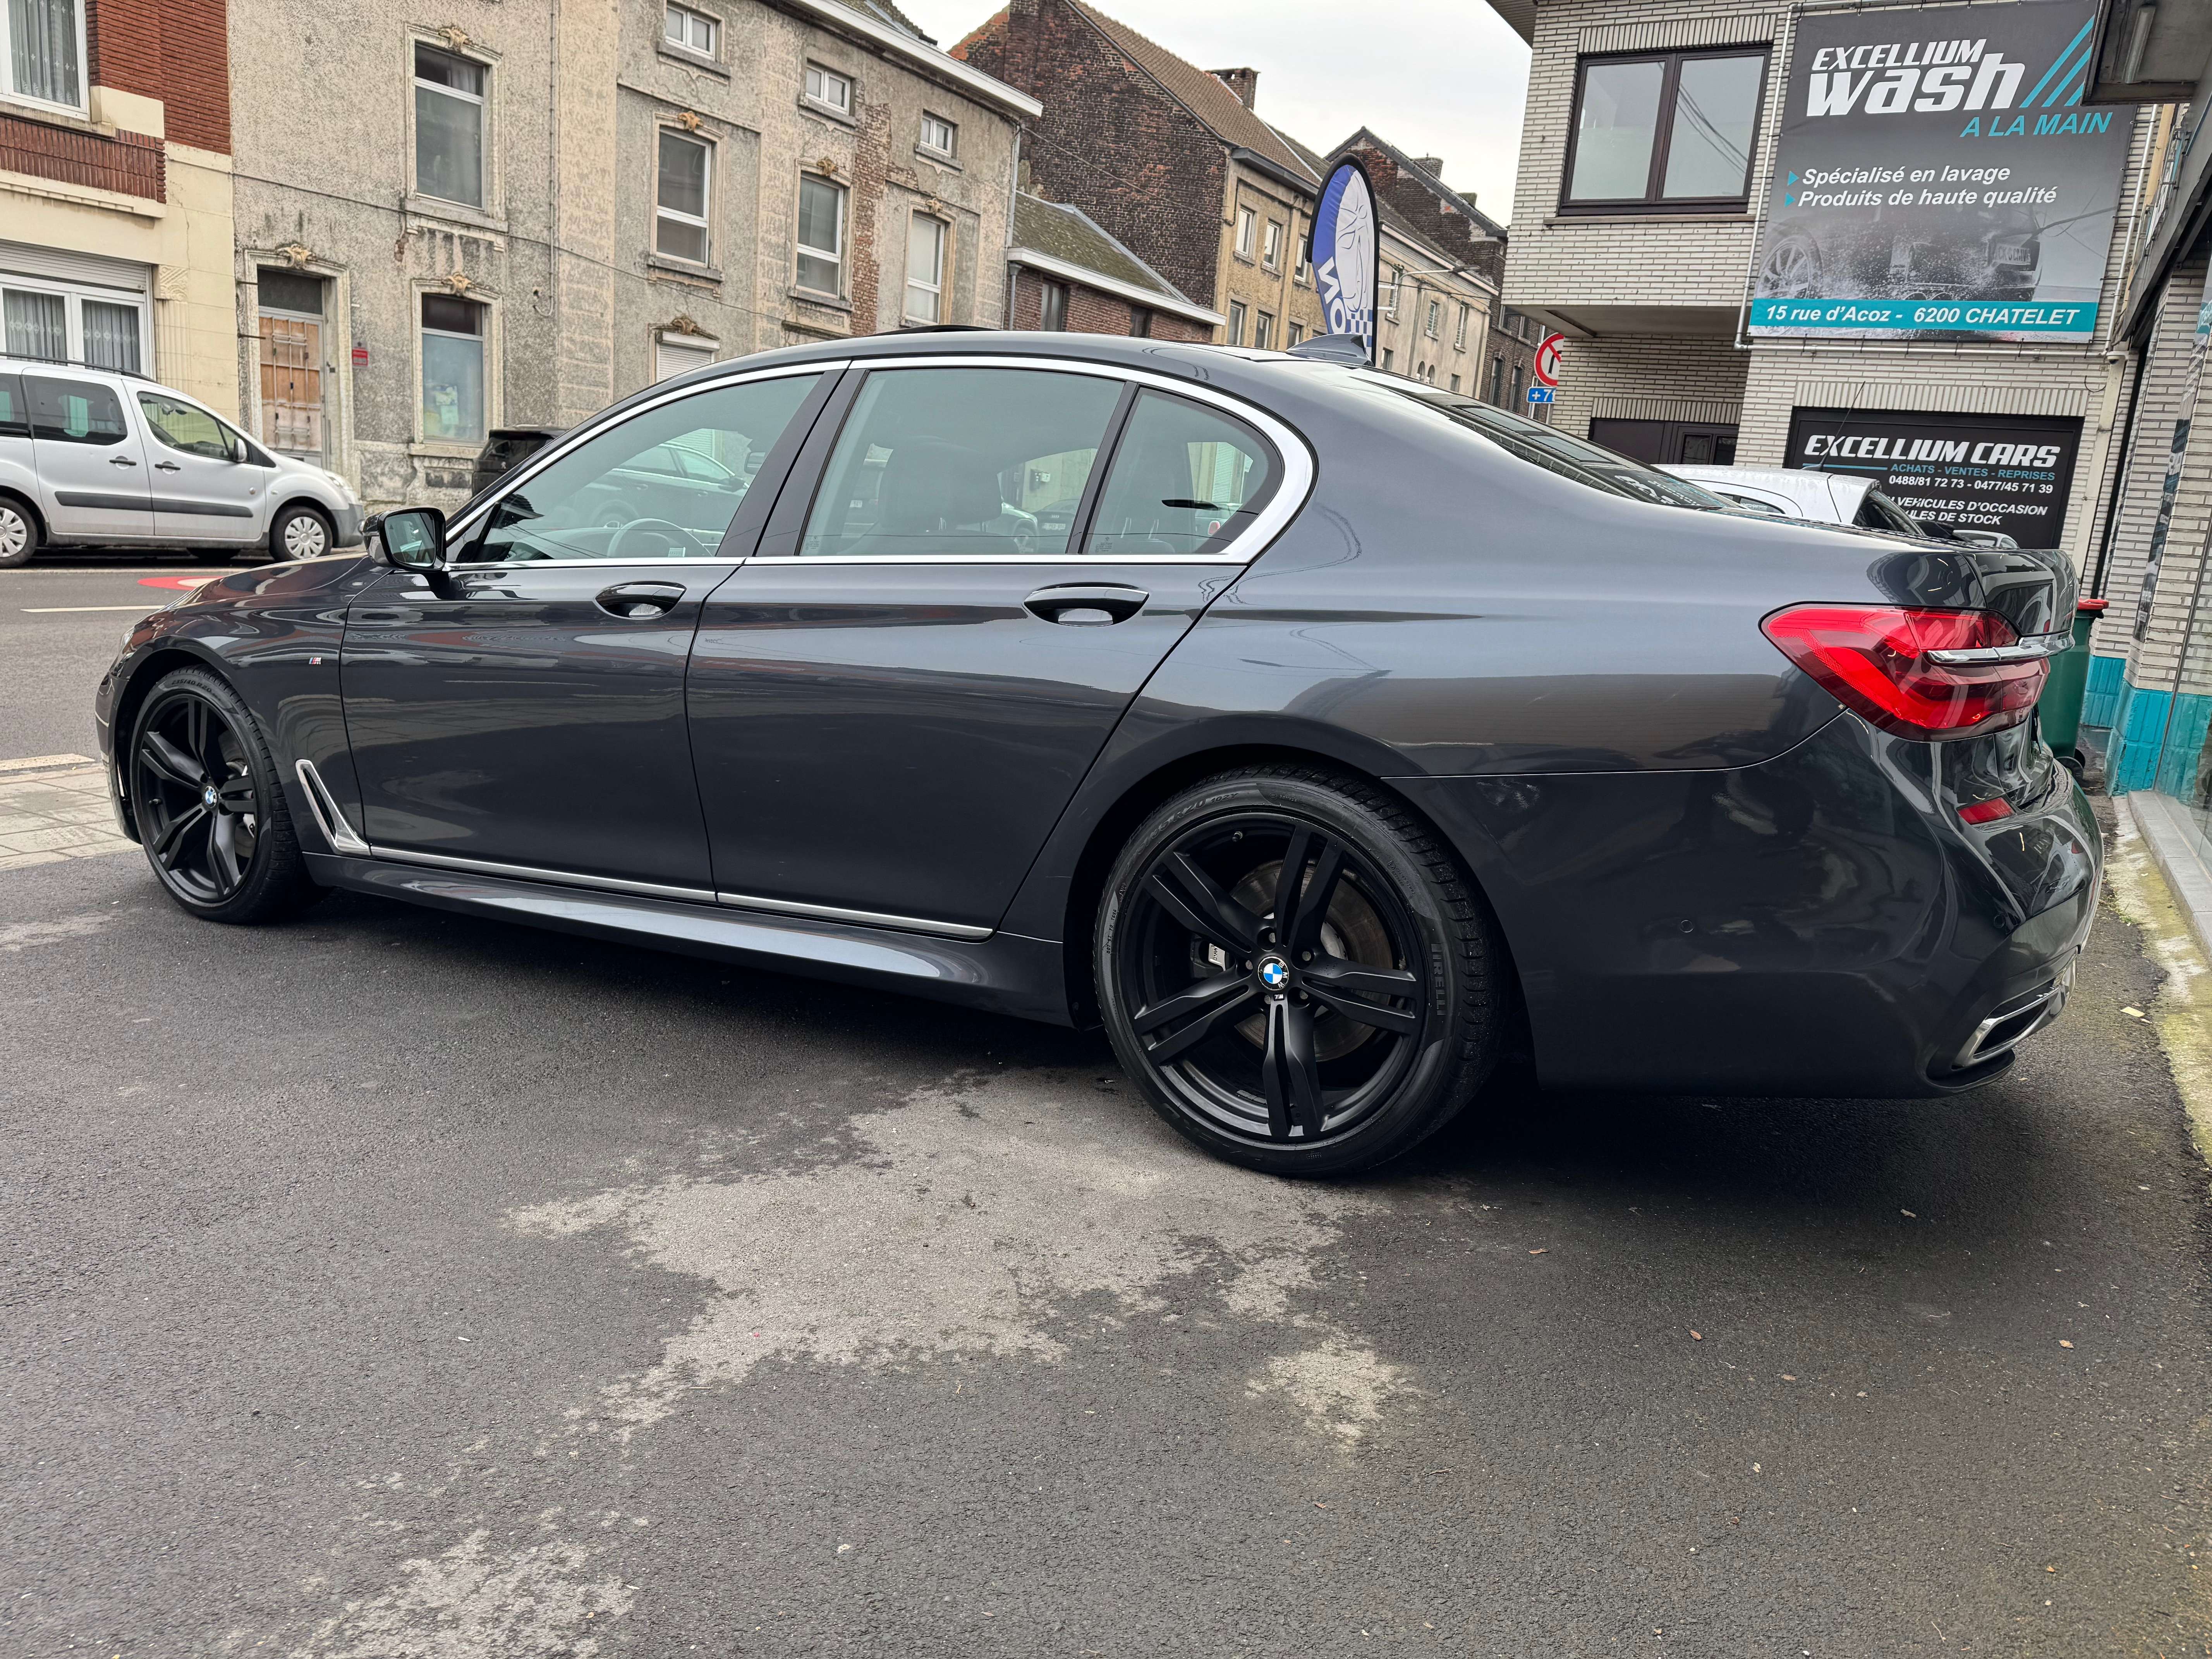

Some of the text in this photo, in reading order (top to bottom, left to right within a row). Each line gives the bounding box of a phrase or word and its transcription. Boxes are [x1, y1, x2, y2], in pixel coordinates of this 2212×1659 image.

[1812, 39, 1987, 70] EXCELLIUM
[1807, 53, 2025, 116] wash
[1960, 112, 2113, 137] A LA MAIN
[1803, 165, 2010, 188] Spécialisé en lavage
[1798, 186, 2058, 208] Produits de haute qualité
[1767, 305, 1788, 320] 15
[1791, 309, 1821, 320] rue
[1914, 307, 1960, 323] 6200
[1966, 308, 2080, 325] CHATELET
[1804, 435, 2061, 467] EXCELLIUM CARS
[1891, 464, 1935, 473] ACHATS
[1945, 466, 1988, 477] VENTES
[1998, 469, 2055, 480] REPRISES
[1889, 475, 1930, 486] 0488/81
[1934, 477, 1948, 487] 72
[1951, 479, 1964, 488] 73
[1974, 480, 2019, 491] 0477/45
[2022, 483, 2035, 493] 71
[2039, 484, 2053, 494] 39
[1898, 497, 1965, 510] VEHICULES
[1937, 512, 1957, 522] DE
[1958, 513, 2002, 525] STOCK
